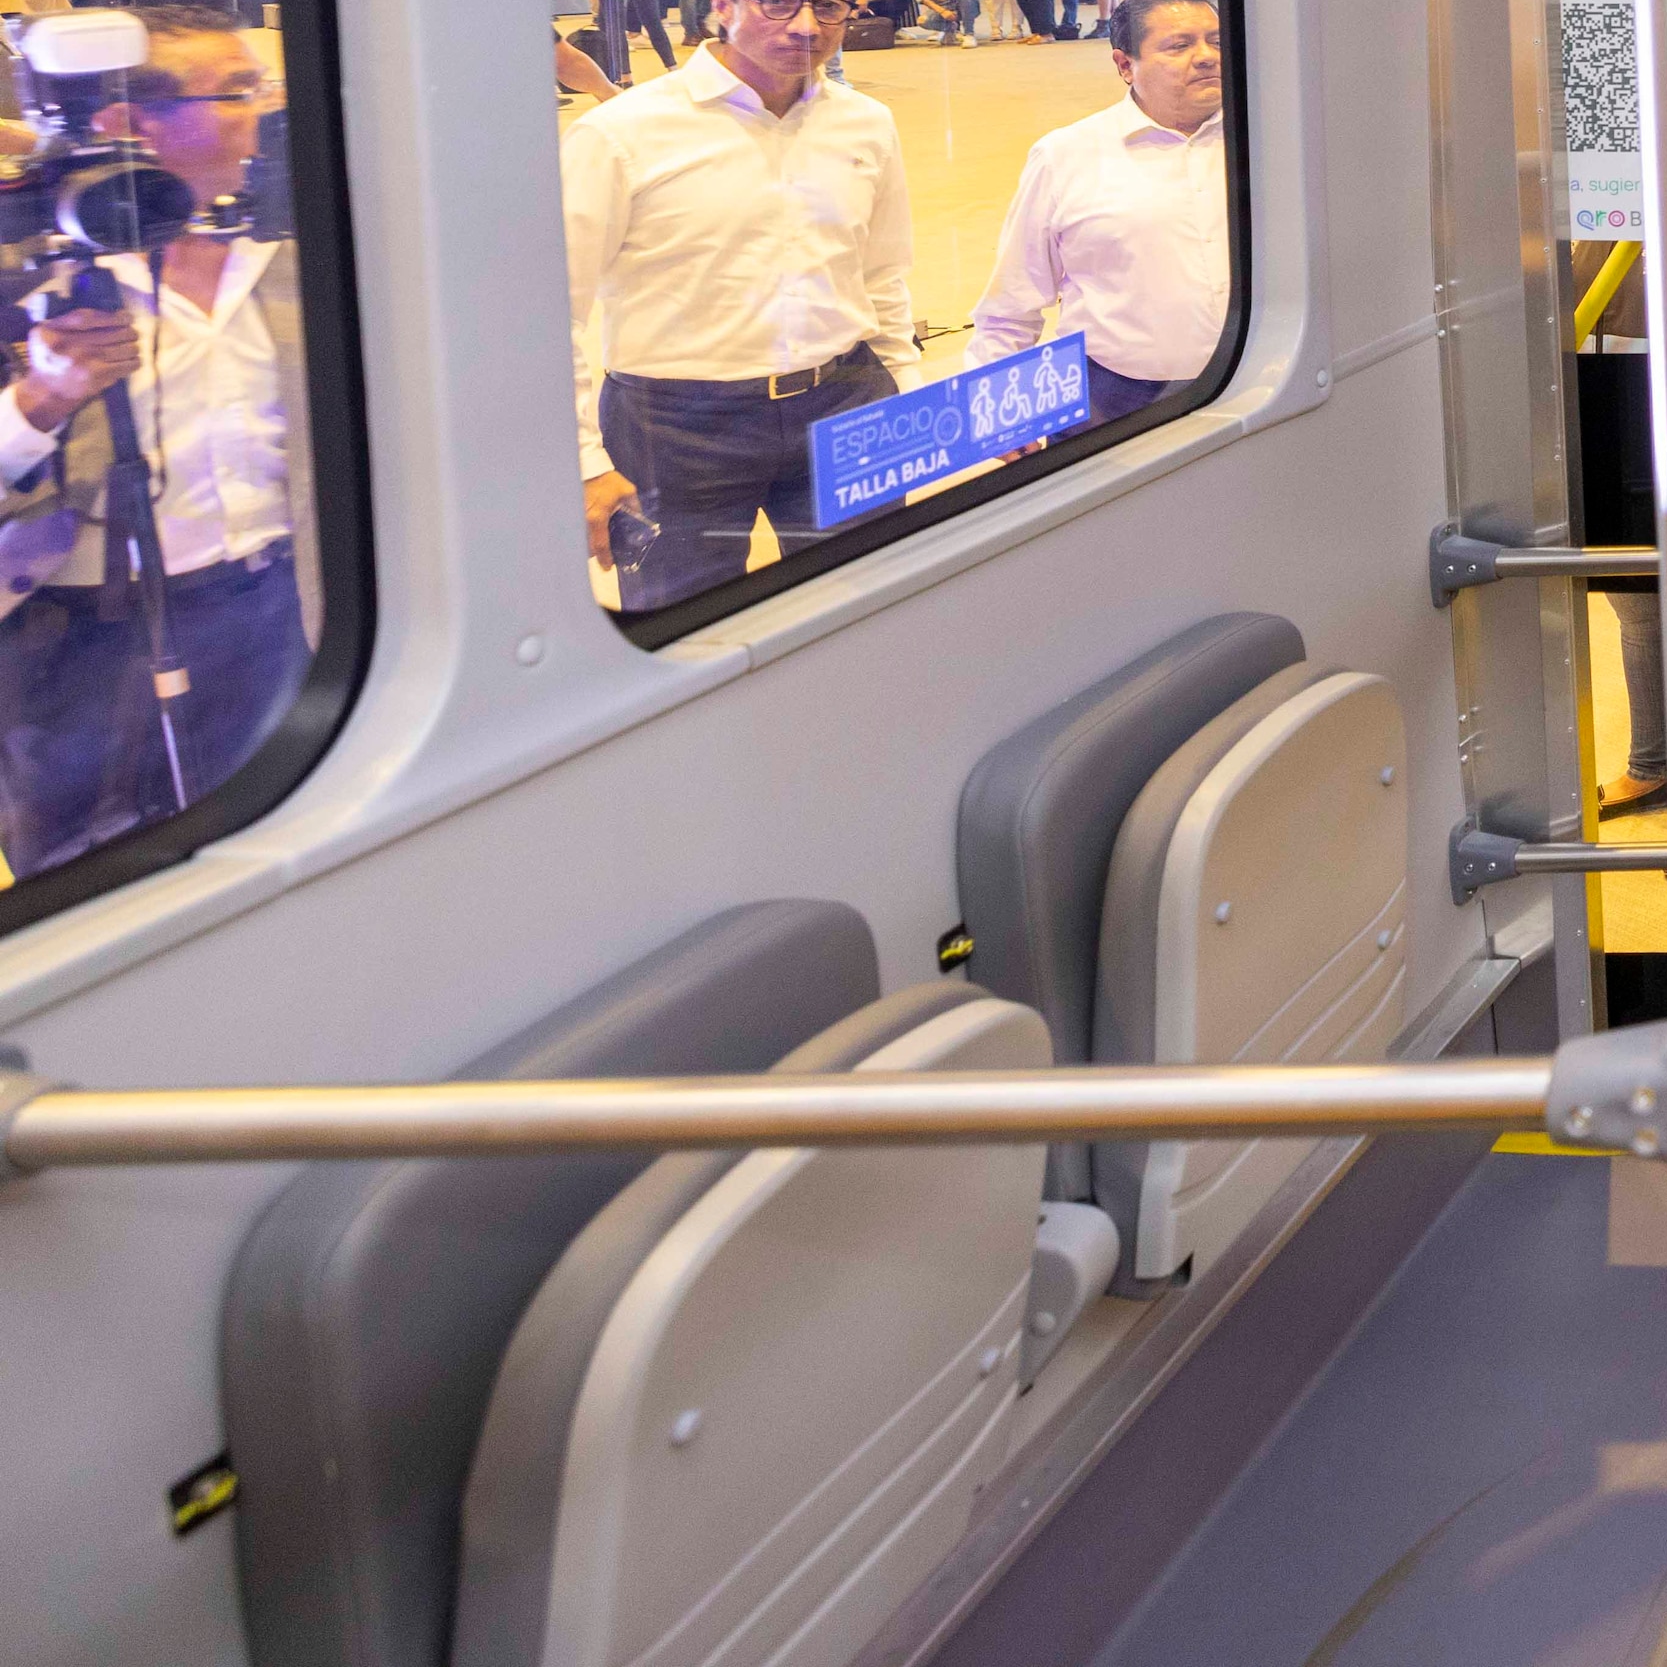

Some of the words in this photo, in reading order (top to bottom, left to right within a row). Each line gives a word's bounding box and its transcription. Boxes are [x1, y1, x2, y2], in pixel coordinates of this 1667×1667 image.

[1588, 177, 1641, 196] sugier
[831, 404, 935, 466] ESPACIO
[834, 467, 898, 510] TALLA
[900, 447, 951, 483] BAJA
